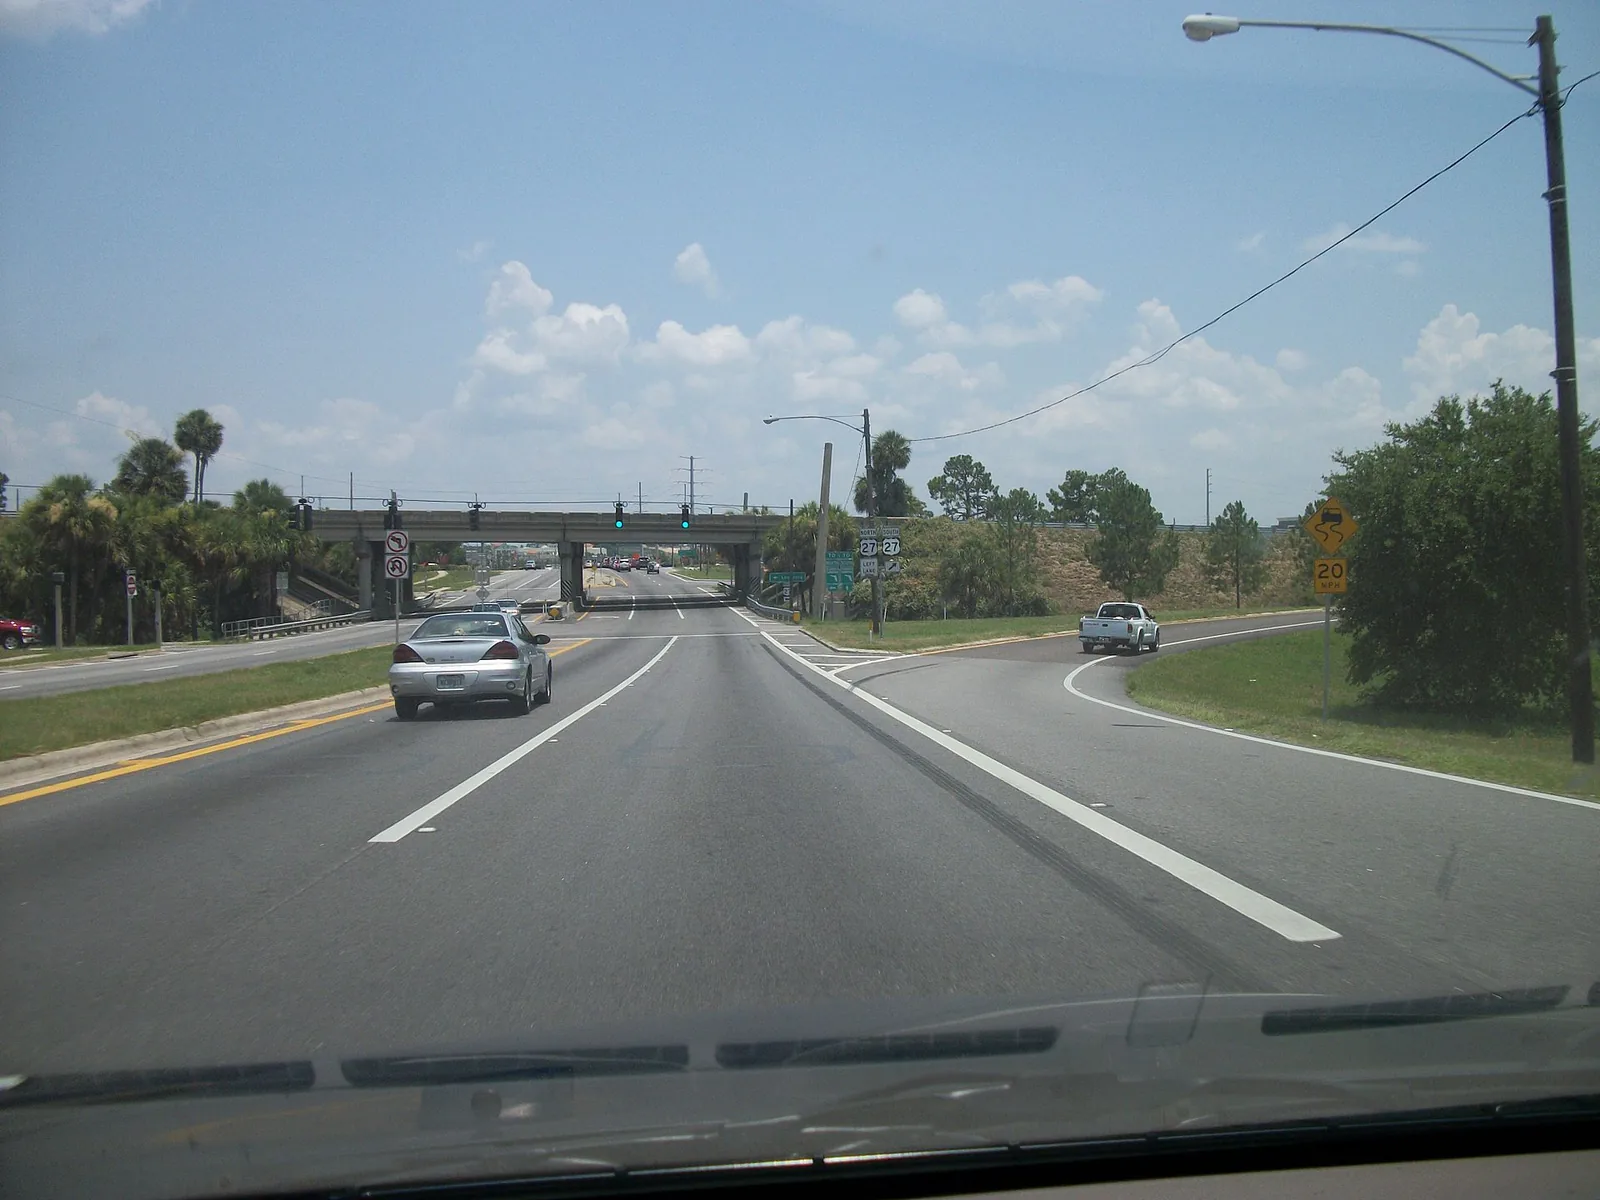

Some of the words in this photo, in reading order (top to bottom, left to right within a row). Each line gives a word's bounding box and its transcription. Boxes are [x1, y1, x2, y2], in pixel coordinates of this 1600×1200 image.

[862, 542, 876, 553] 27
[884, 542, 898, 552] 27
[1318, 563, 1343, 579] 20
